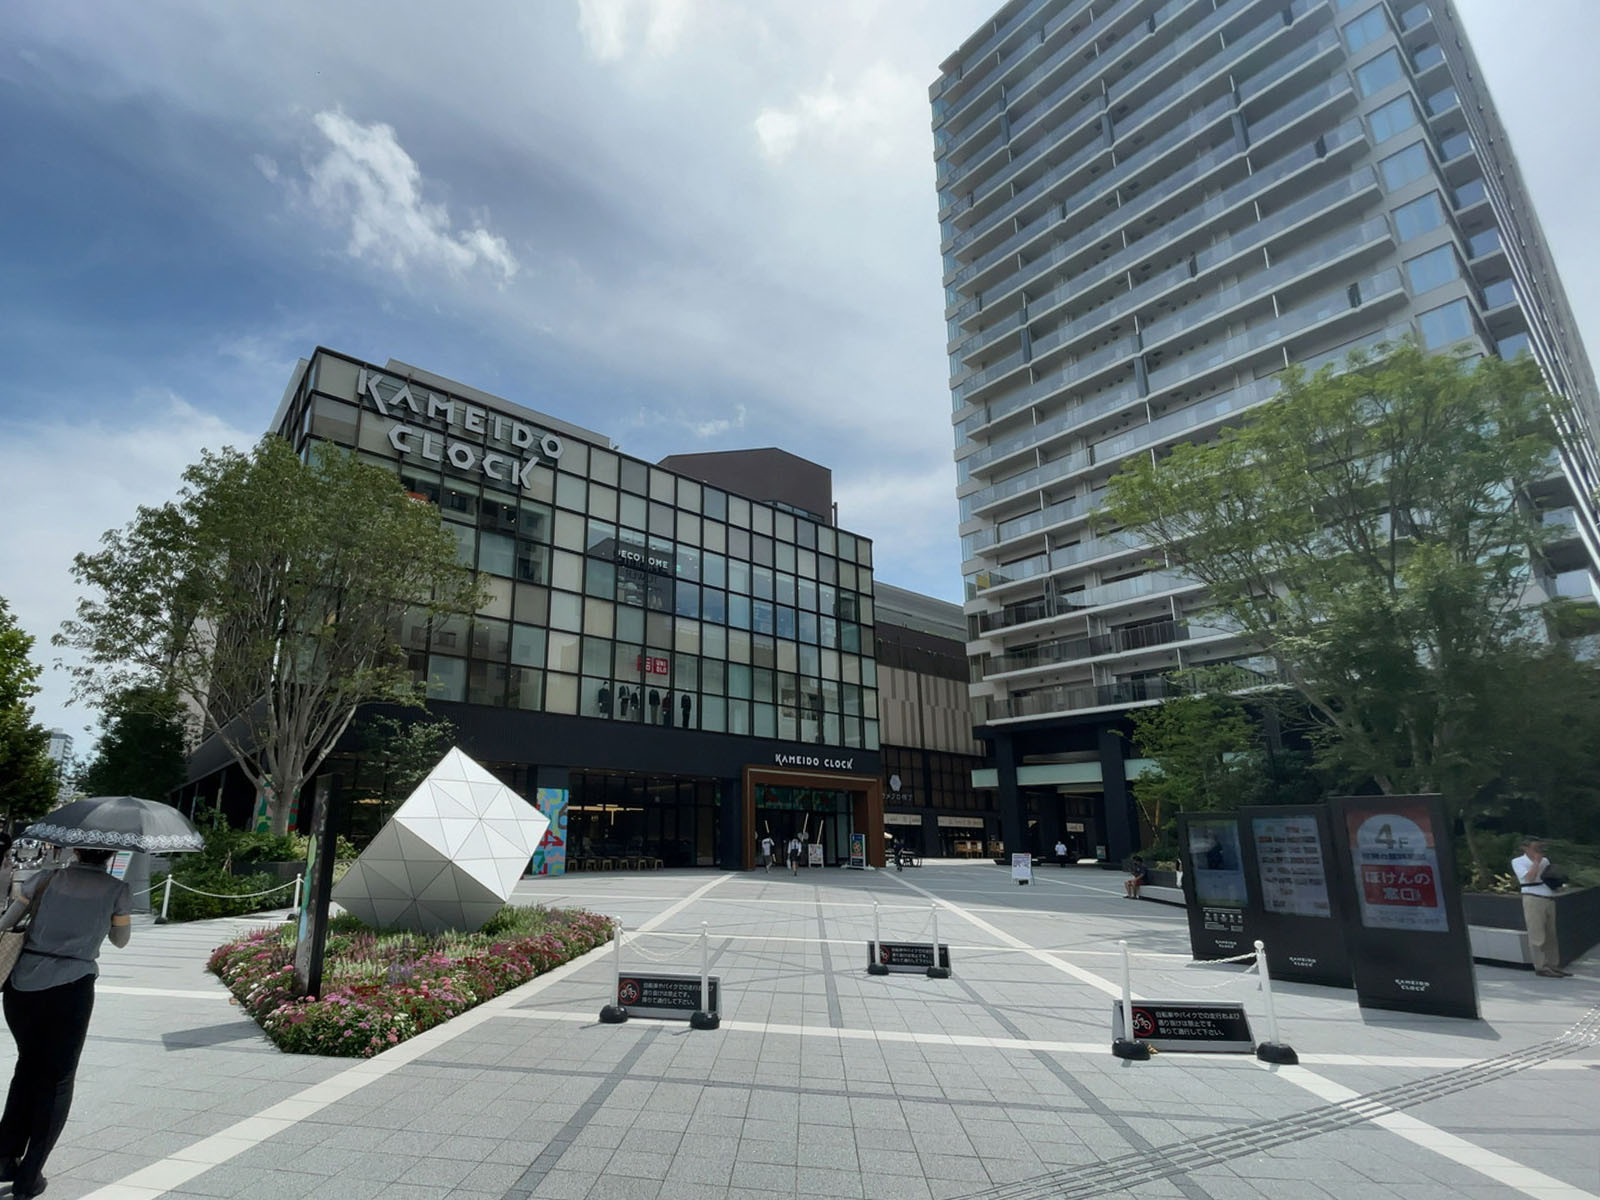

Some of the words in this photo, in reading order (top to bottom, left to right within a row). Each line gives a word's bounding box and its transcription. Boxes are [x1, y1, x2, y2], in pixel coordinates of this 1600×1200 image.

[357, 368, 565, 460] KAMEIDO
[388, 423, 540, 490] CLOCK
[775, 753, 820, 767] KAMEIDO
[824, 758, 854, 770] CLOCK
